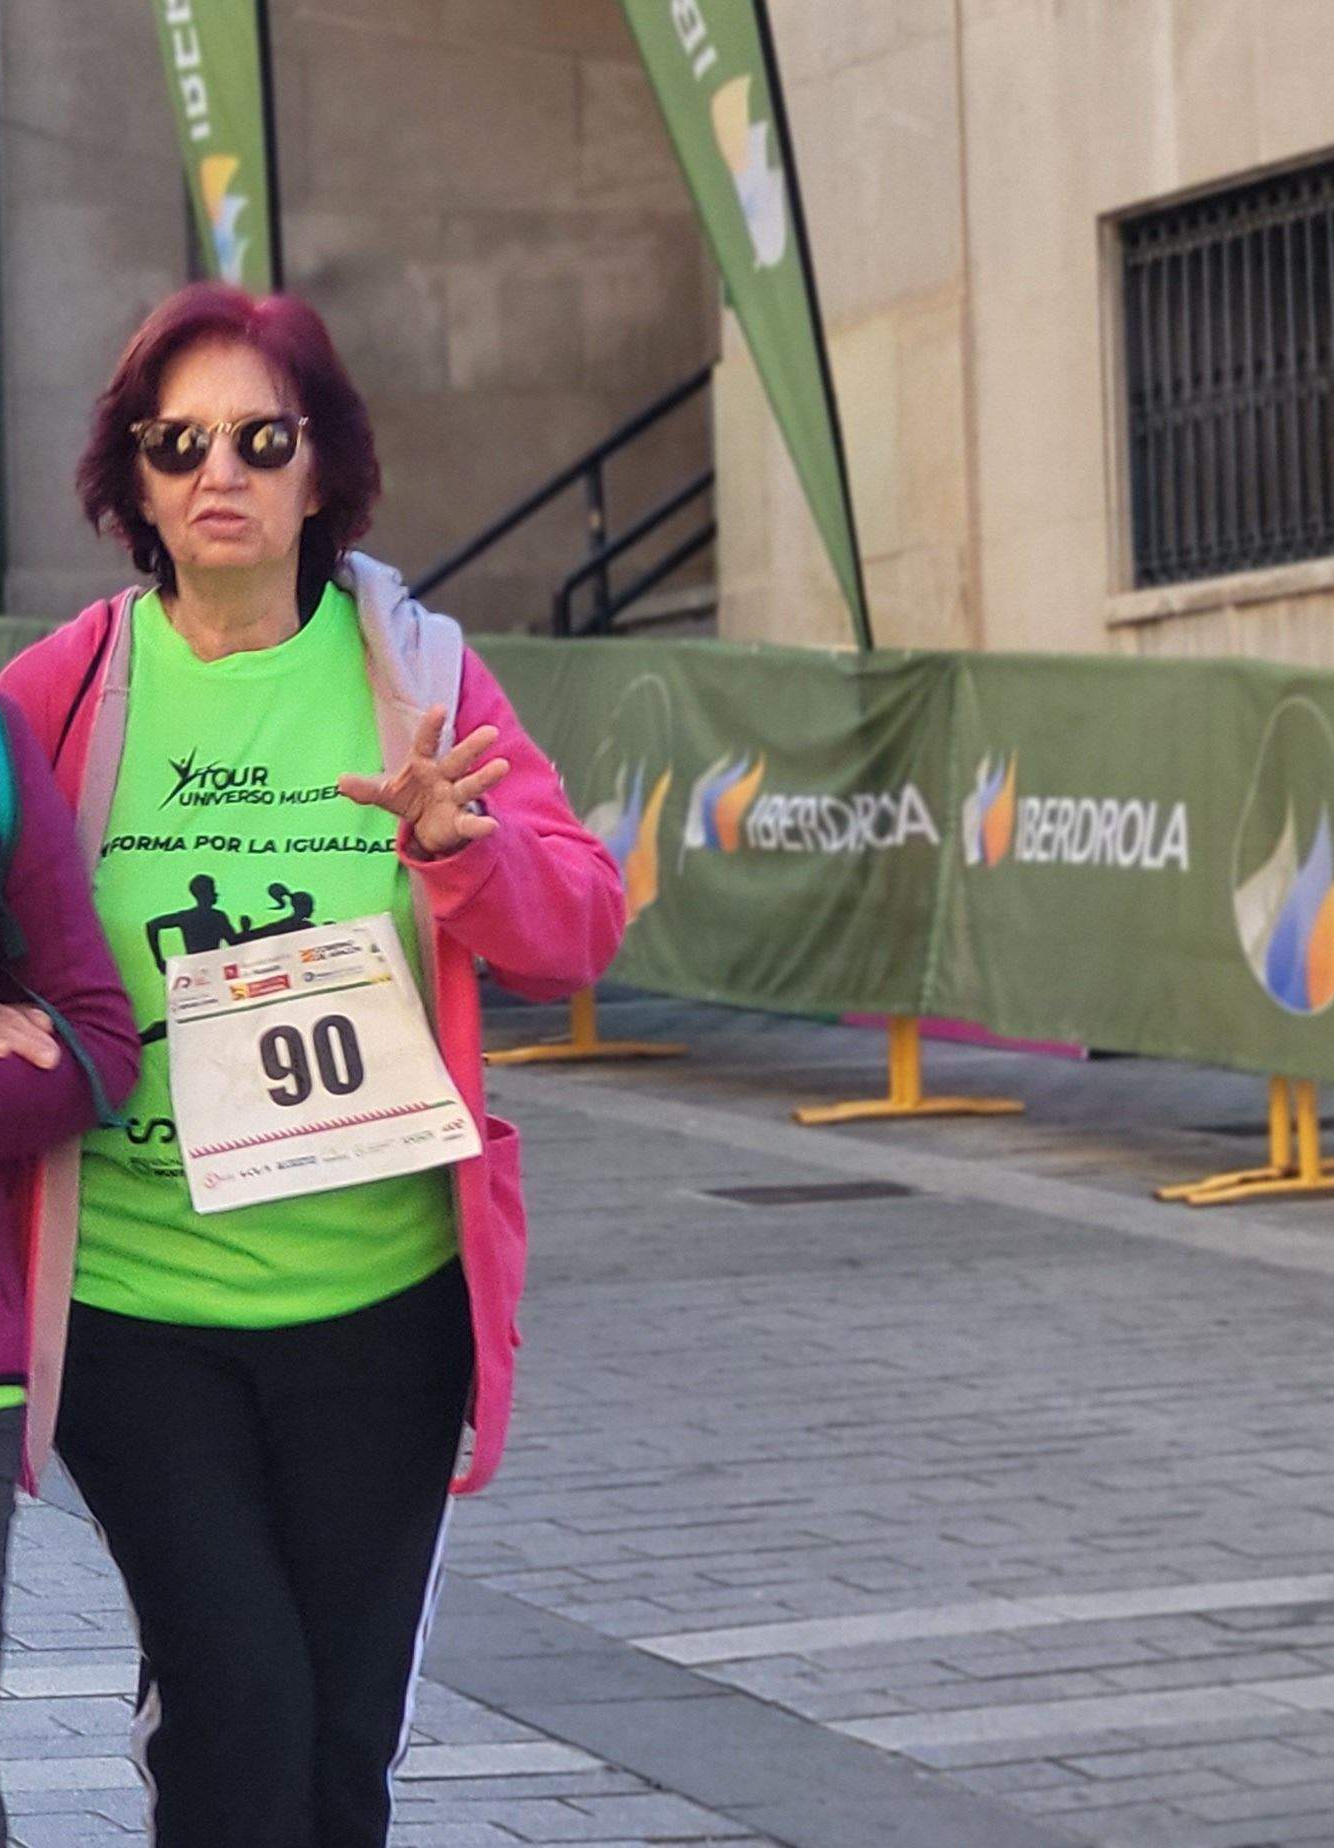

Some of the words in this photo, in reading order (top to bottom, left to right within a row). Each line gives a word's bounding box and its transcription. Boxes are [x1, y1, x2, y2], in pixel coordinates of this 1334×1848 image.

[194, 766, 269, 791] TOUR
[178, 790, 275, 807] UNIVERSO
[193, 835, 242, 853] POR
[247, 838, 277, 854] LA
[1014, 798, 1190, 871] IBERDROLA
[259, 1014, 365, 1108] 90
